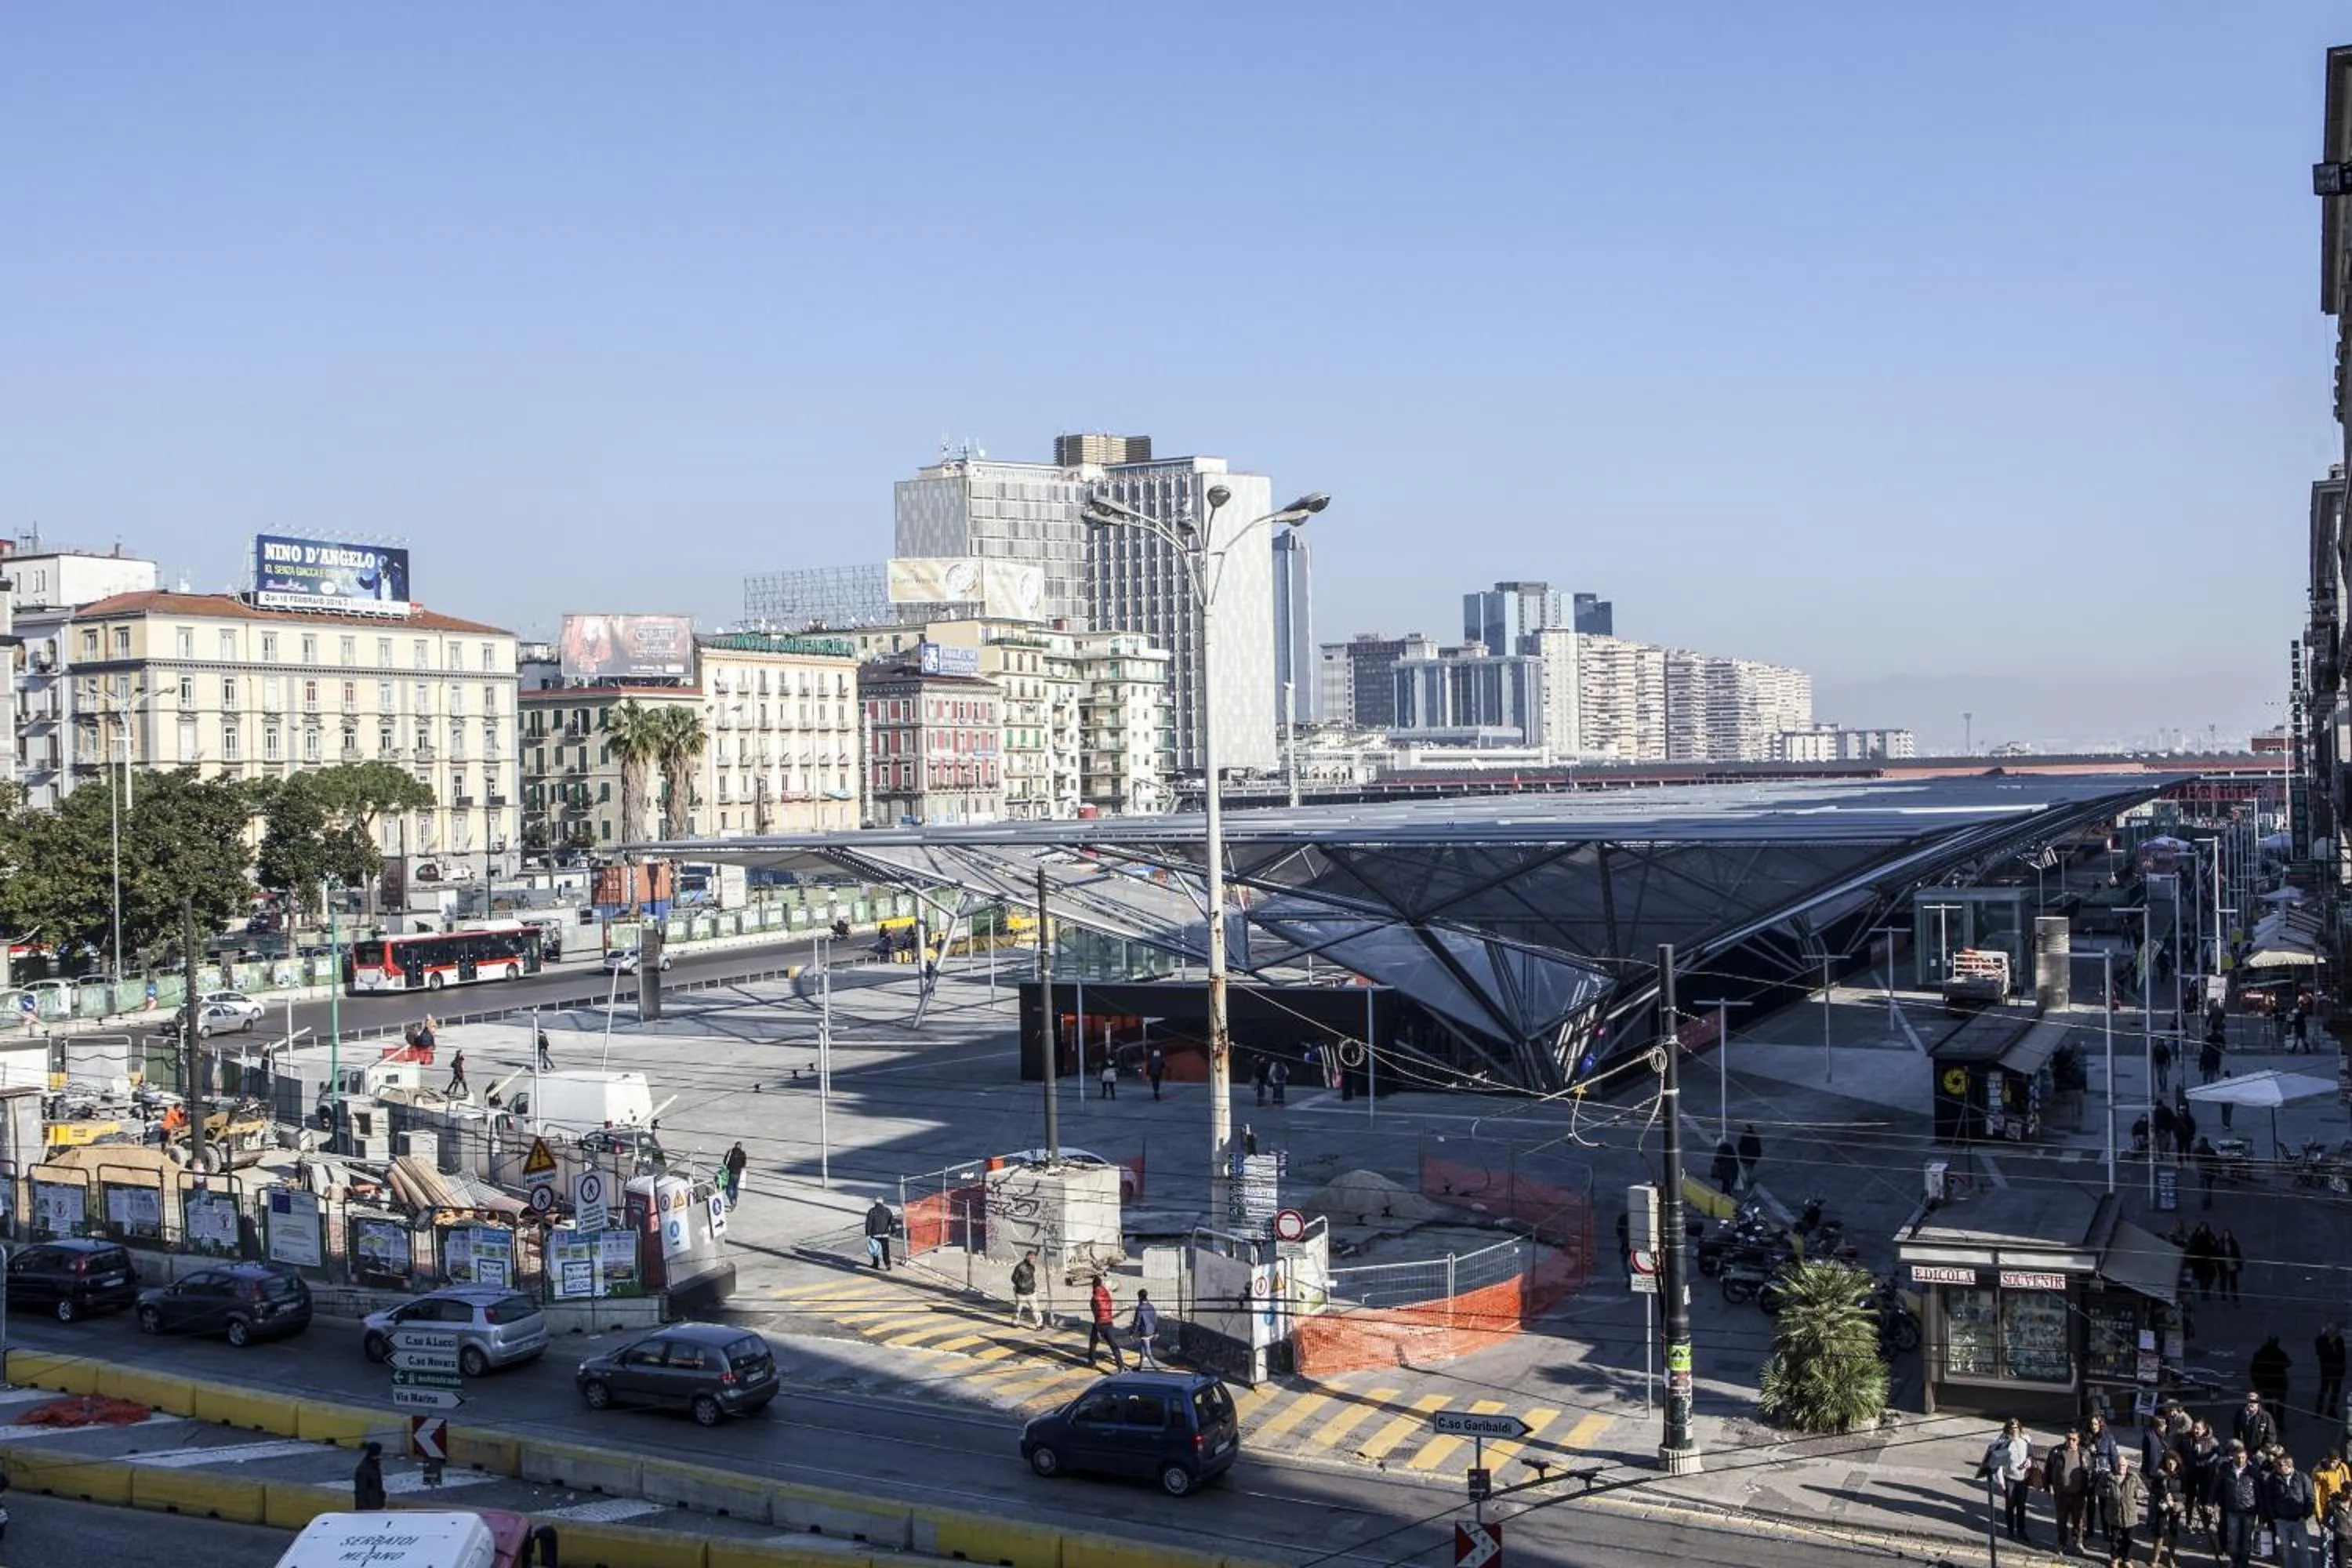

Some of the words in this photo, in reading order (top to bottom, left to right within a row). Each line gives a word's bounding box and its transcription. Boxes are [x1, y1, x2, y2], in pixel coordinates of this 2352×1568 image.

[264, 543, 301, 562] NINO
[305, 546, 376, 569] D'ANGELO
[1915, 1268, 1973, 1282] EDICOLA
[405, 1335, 424, 1346] C.so
[408, 1355, 426, 1366] C.so
[394, 1392, 408, 1403] Via
[1438, 1417, 1461, 1430] C.so
[1464, 1420, 1512, 1435] Garibaldi
